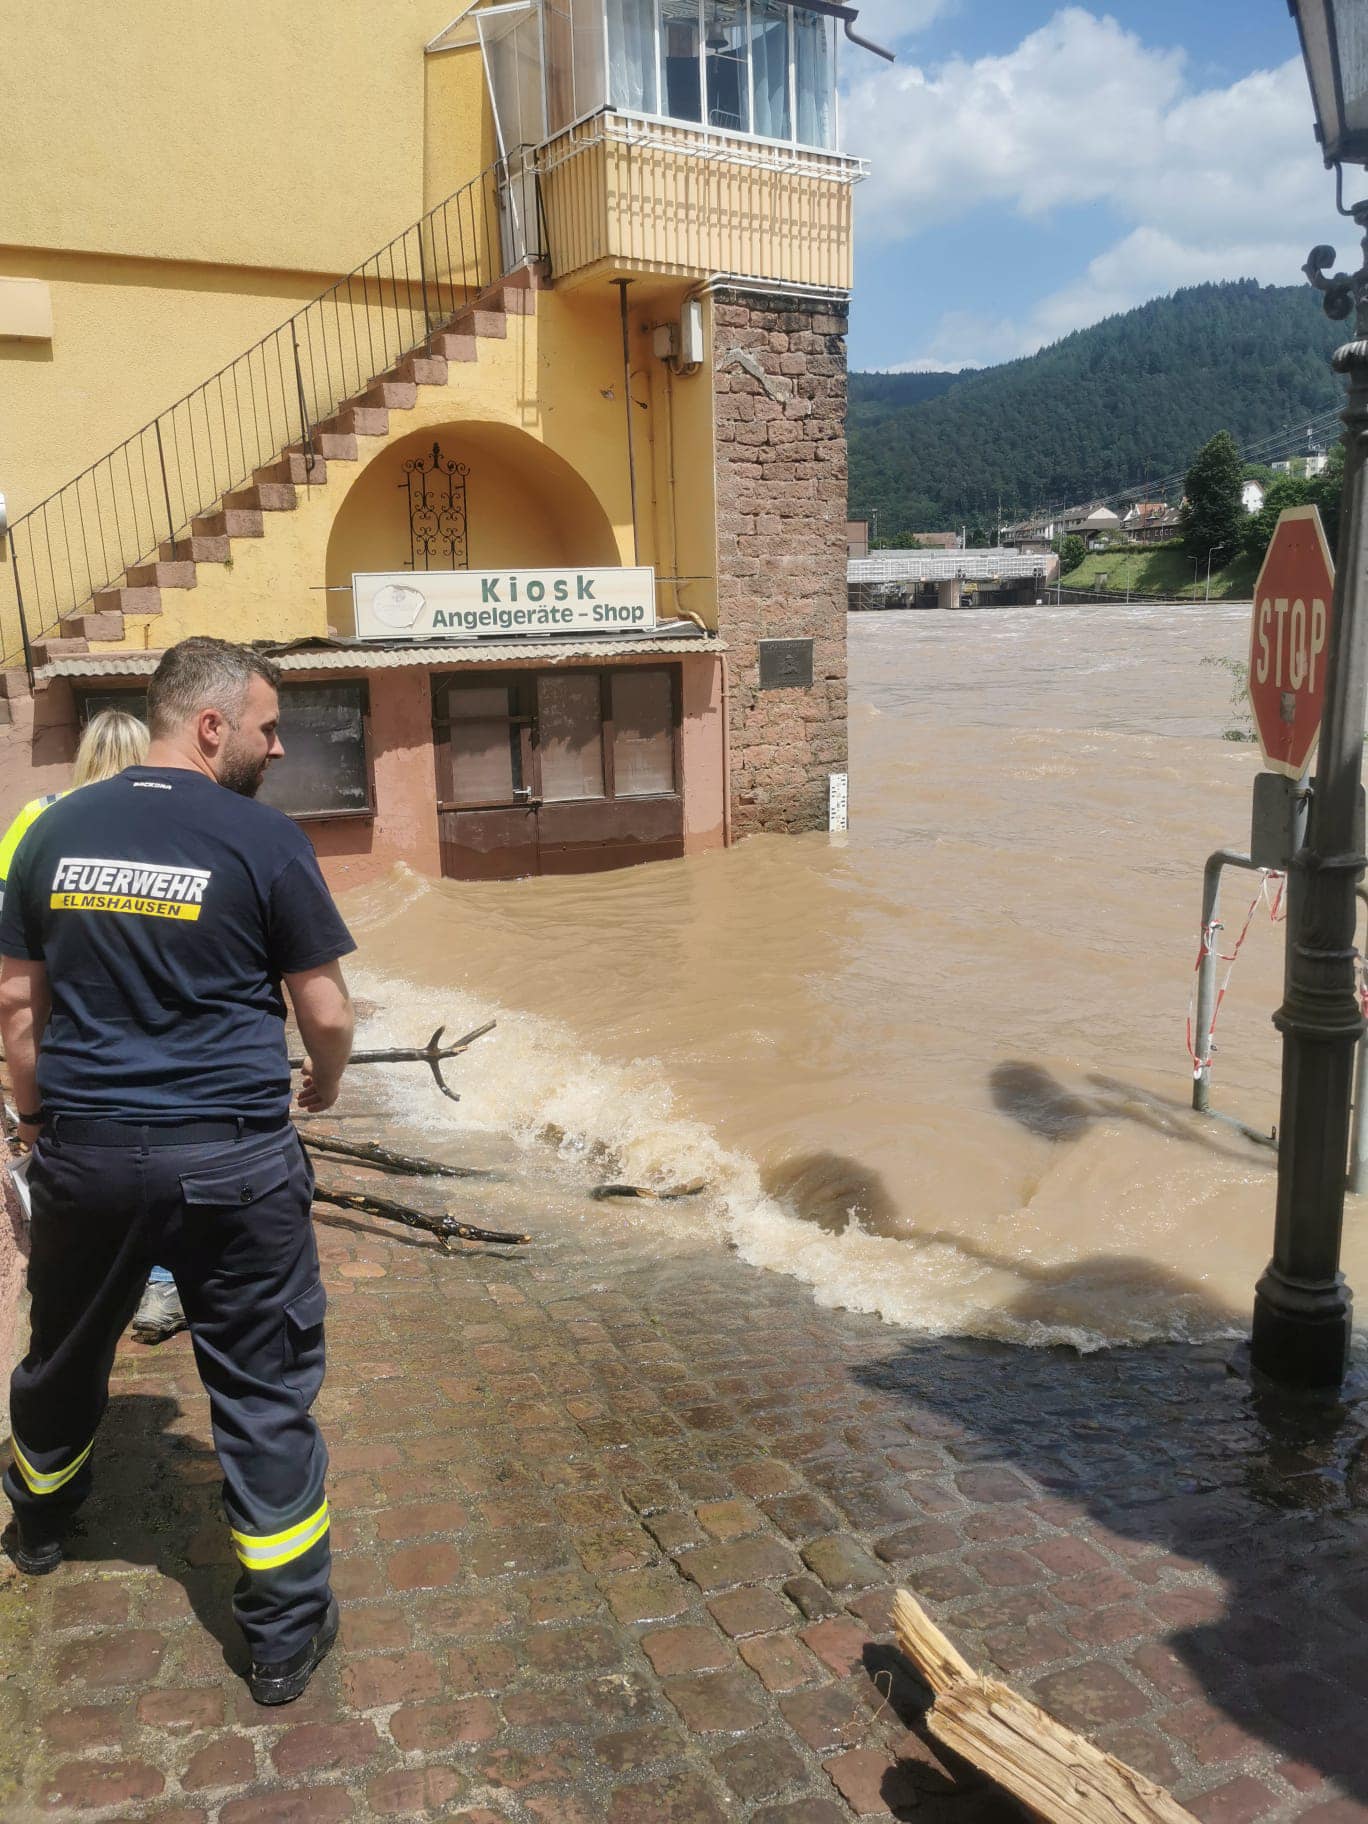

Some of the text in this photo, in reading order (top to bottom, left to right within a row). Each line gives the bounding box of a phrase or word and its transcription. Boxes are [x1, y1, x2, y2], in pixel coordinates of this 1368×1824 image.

[481, 575, 596, 603] Kiosk
[432, 604, 574, 629] Angelgeräte
[592, 603, 644, 624] Shop
[1256, 598, 1326, 694] STOP
[52, 857, 212, 902] FEUERWEHR
[63, 895, 181, 916] ELMSHAUSEN
